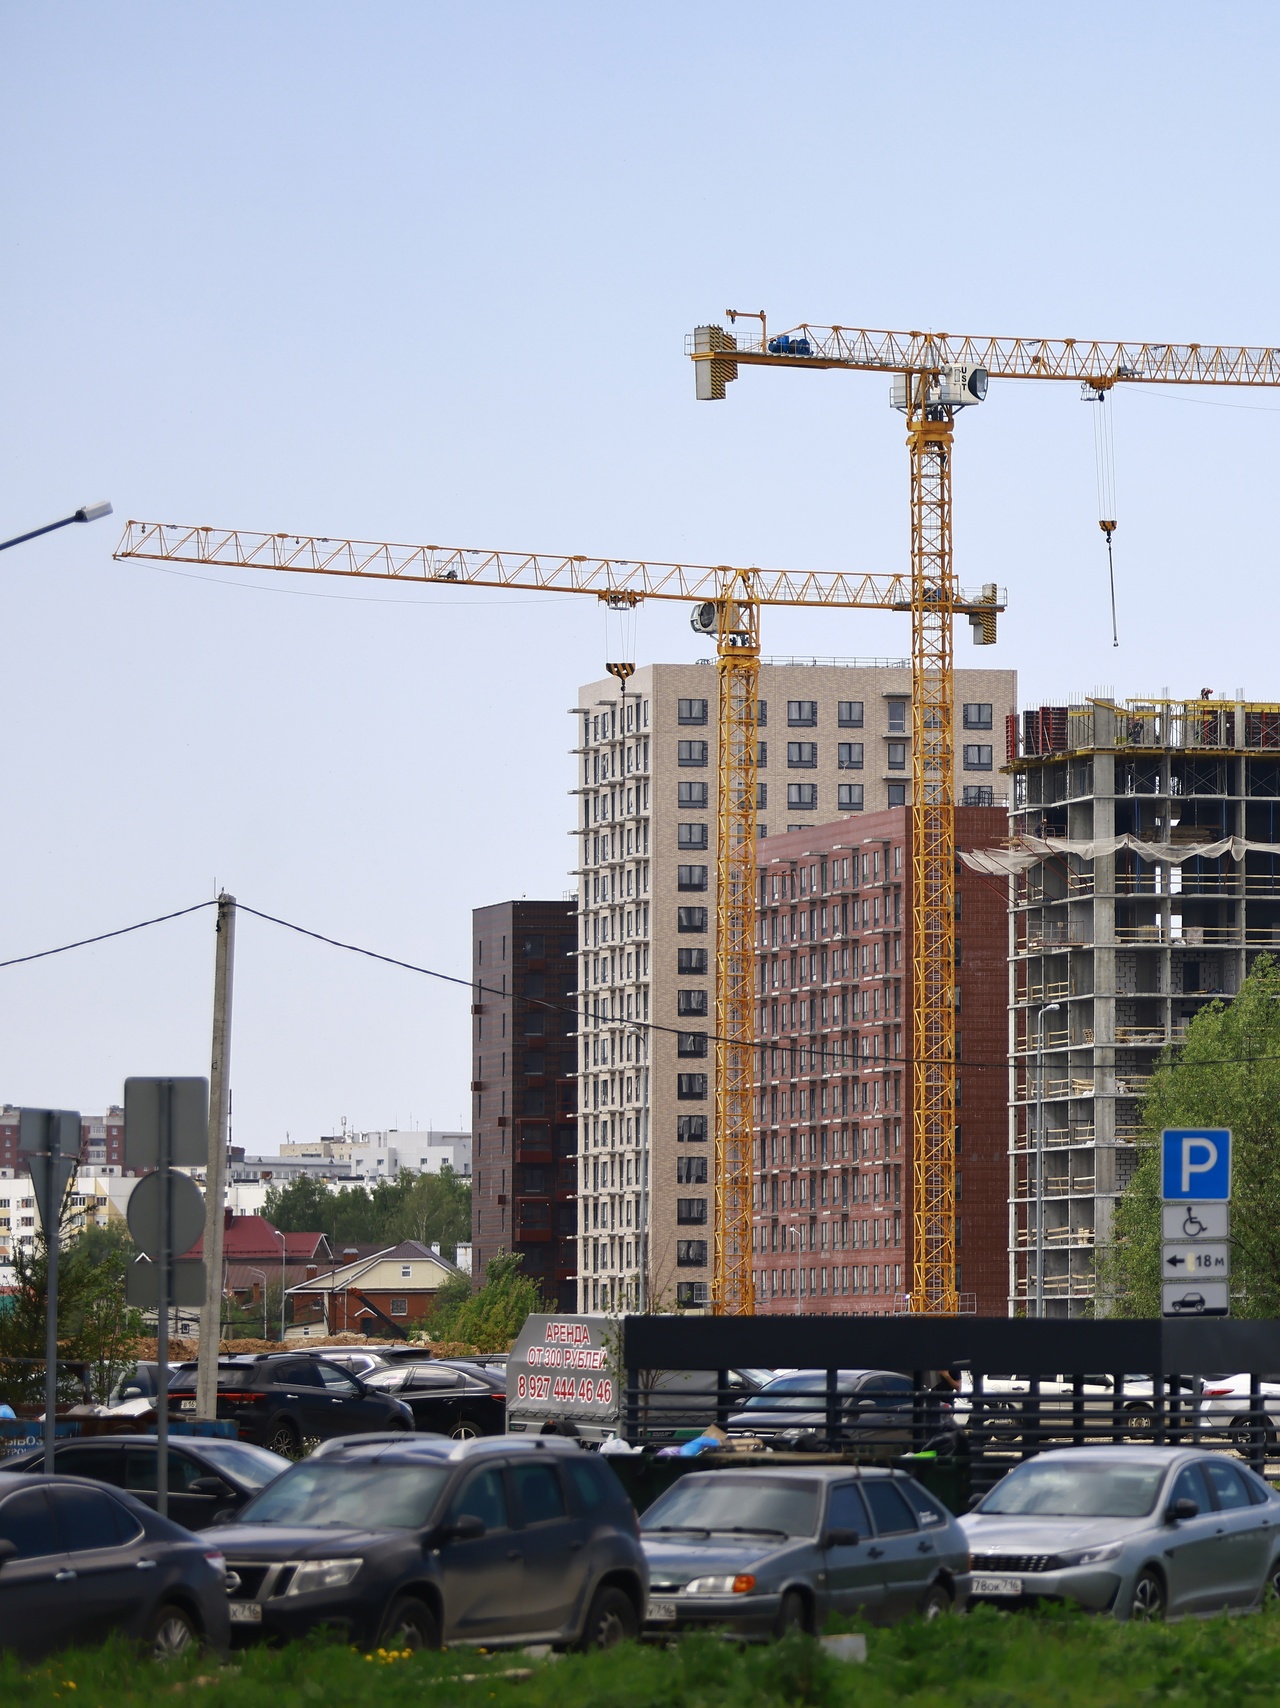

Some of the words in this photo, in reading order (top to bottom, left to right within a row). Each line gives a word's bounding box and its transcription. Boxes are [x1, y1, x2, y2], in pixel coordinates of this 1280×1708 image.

[1181, 1137, 1218, 1192] P
[1195, 1254, 1212, 1267] 18
[545, 1323, 590, 1347] АРЕНДА
[527, 1346, 544, 1366] ОТ
[544, 1348, 562, 1368] 300
[563, 1347, 607, 1371] РУБЛЕЙ
[518, 1374, 527, 1398] 8
[529, 1375, 551, 1400] 927
[553, 1377, 576, 1402] 444
[578, 1378, 593, 1403] 46
[596, 1379, 612, 1404] 46
